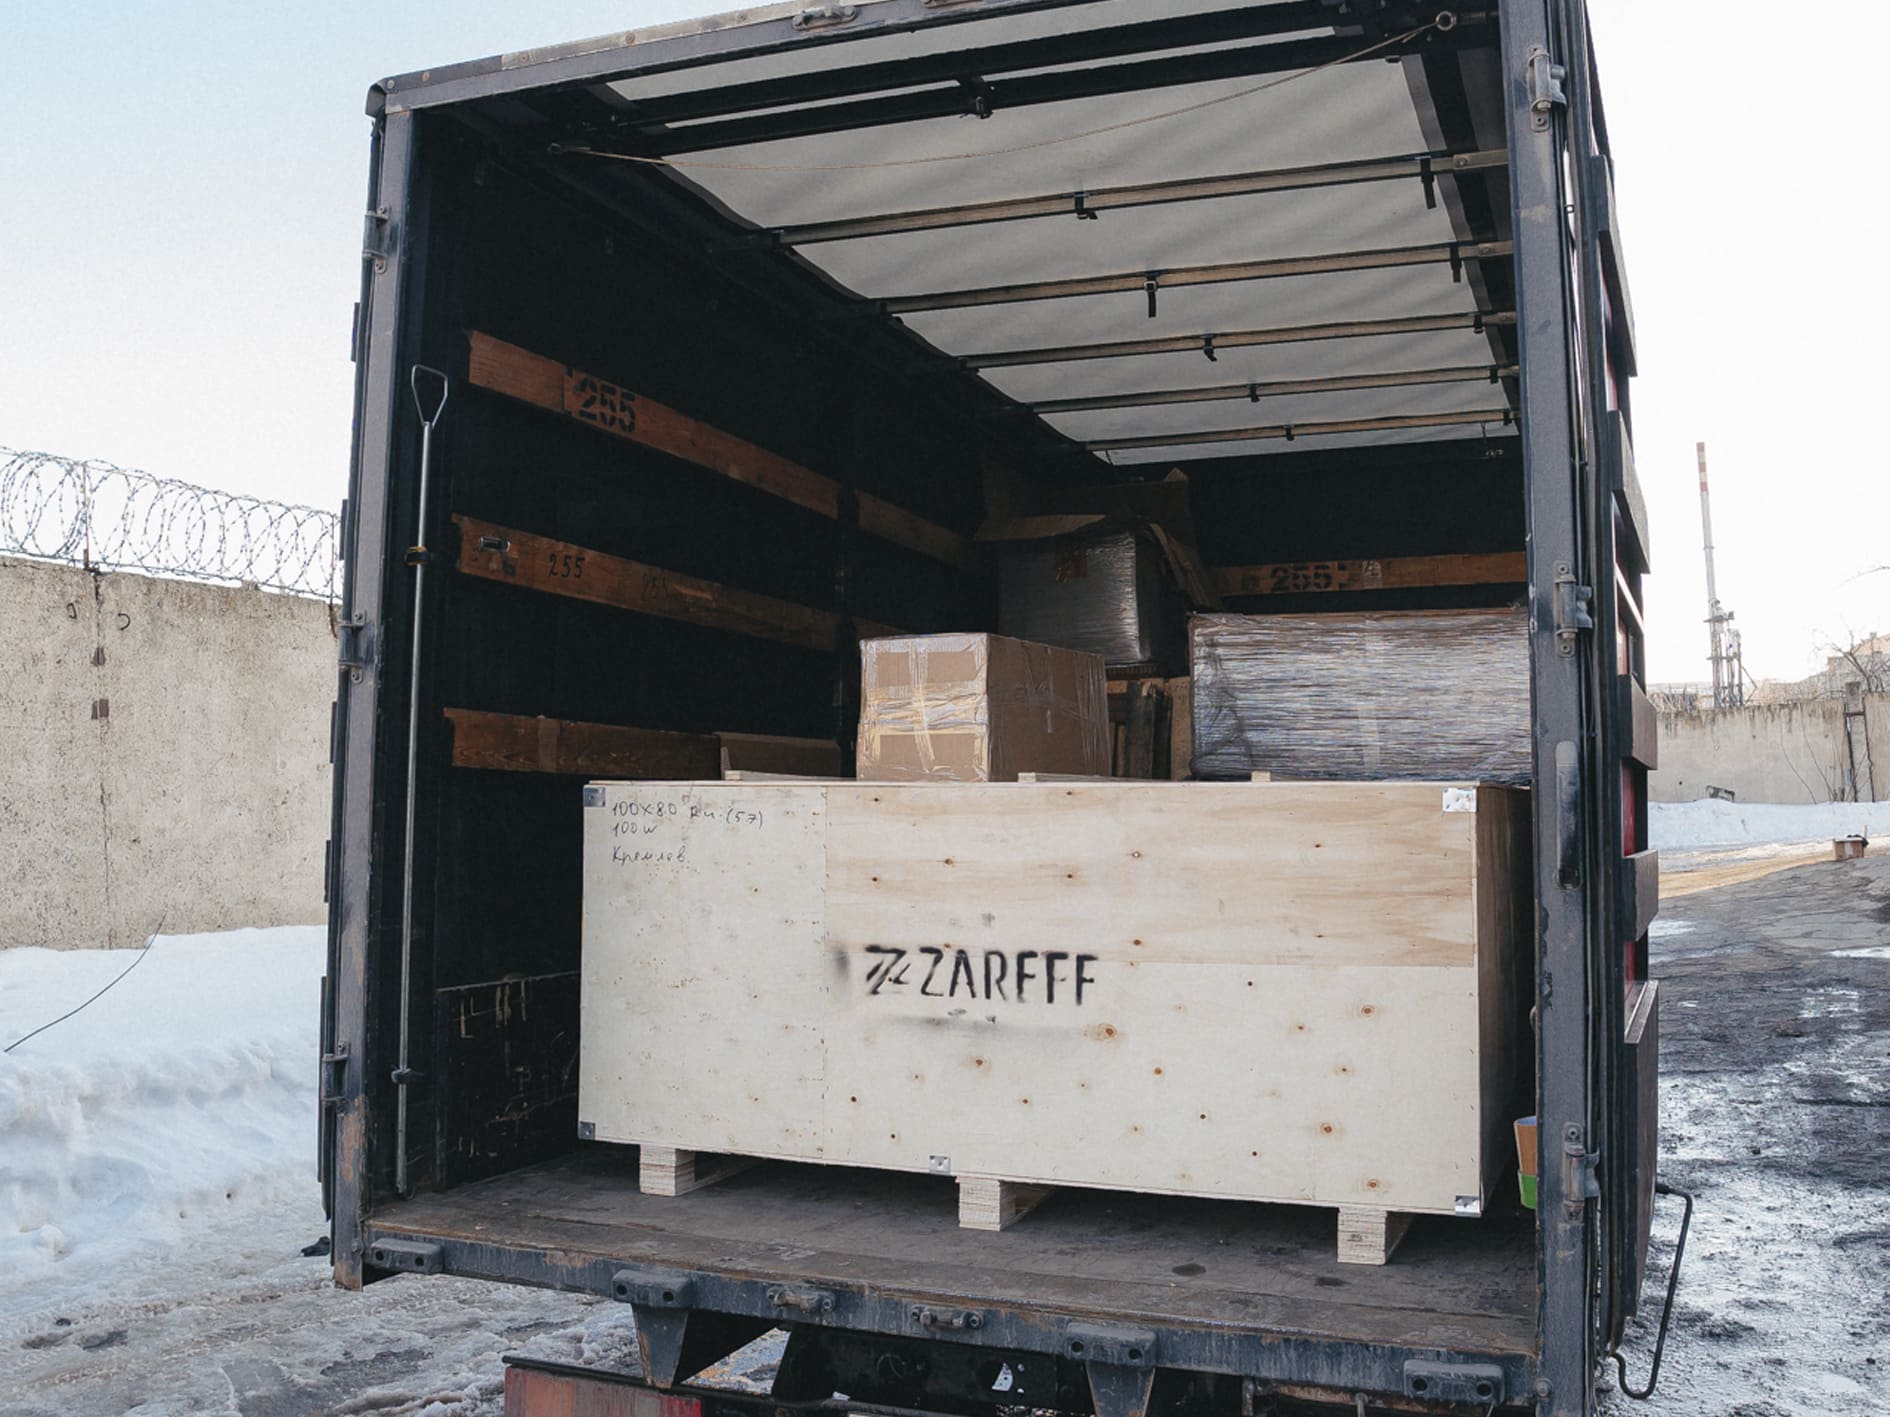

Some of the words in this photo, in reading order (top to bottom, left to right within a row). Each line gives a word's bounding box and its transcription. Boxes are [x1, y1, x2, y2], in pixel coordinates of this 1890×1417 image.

[578, 378, 635, 432] 255
[548, 553, 585, 578] 255
[1271, 564, 1333, 591] 255
